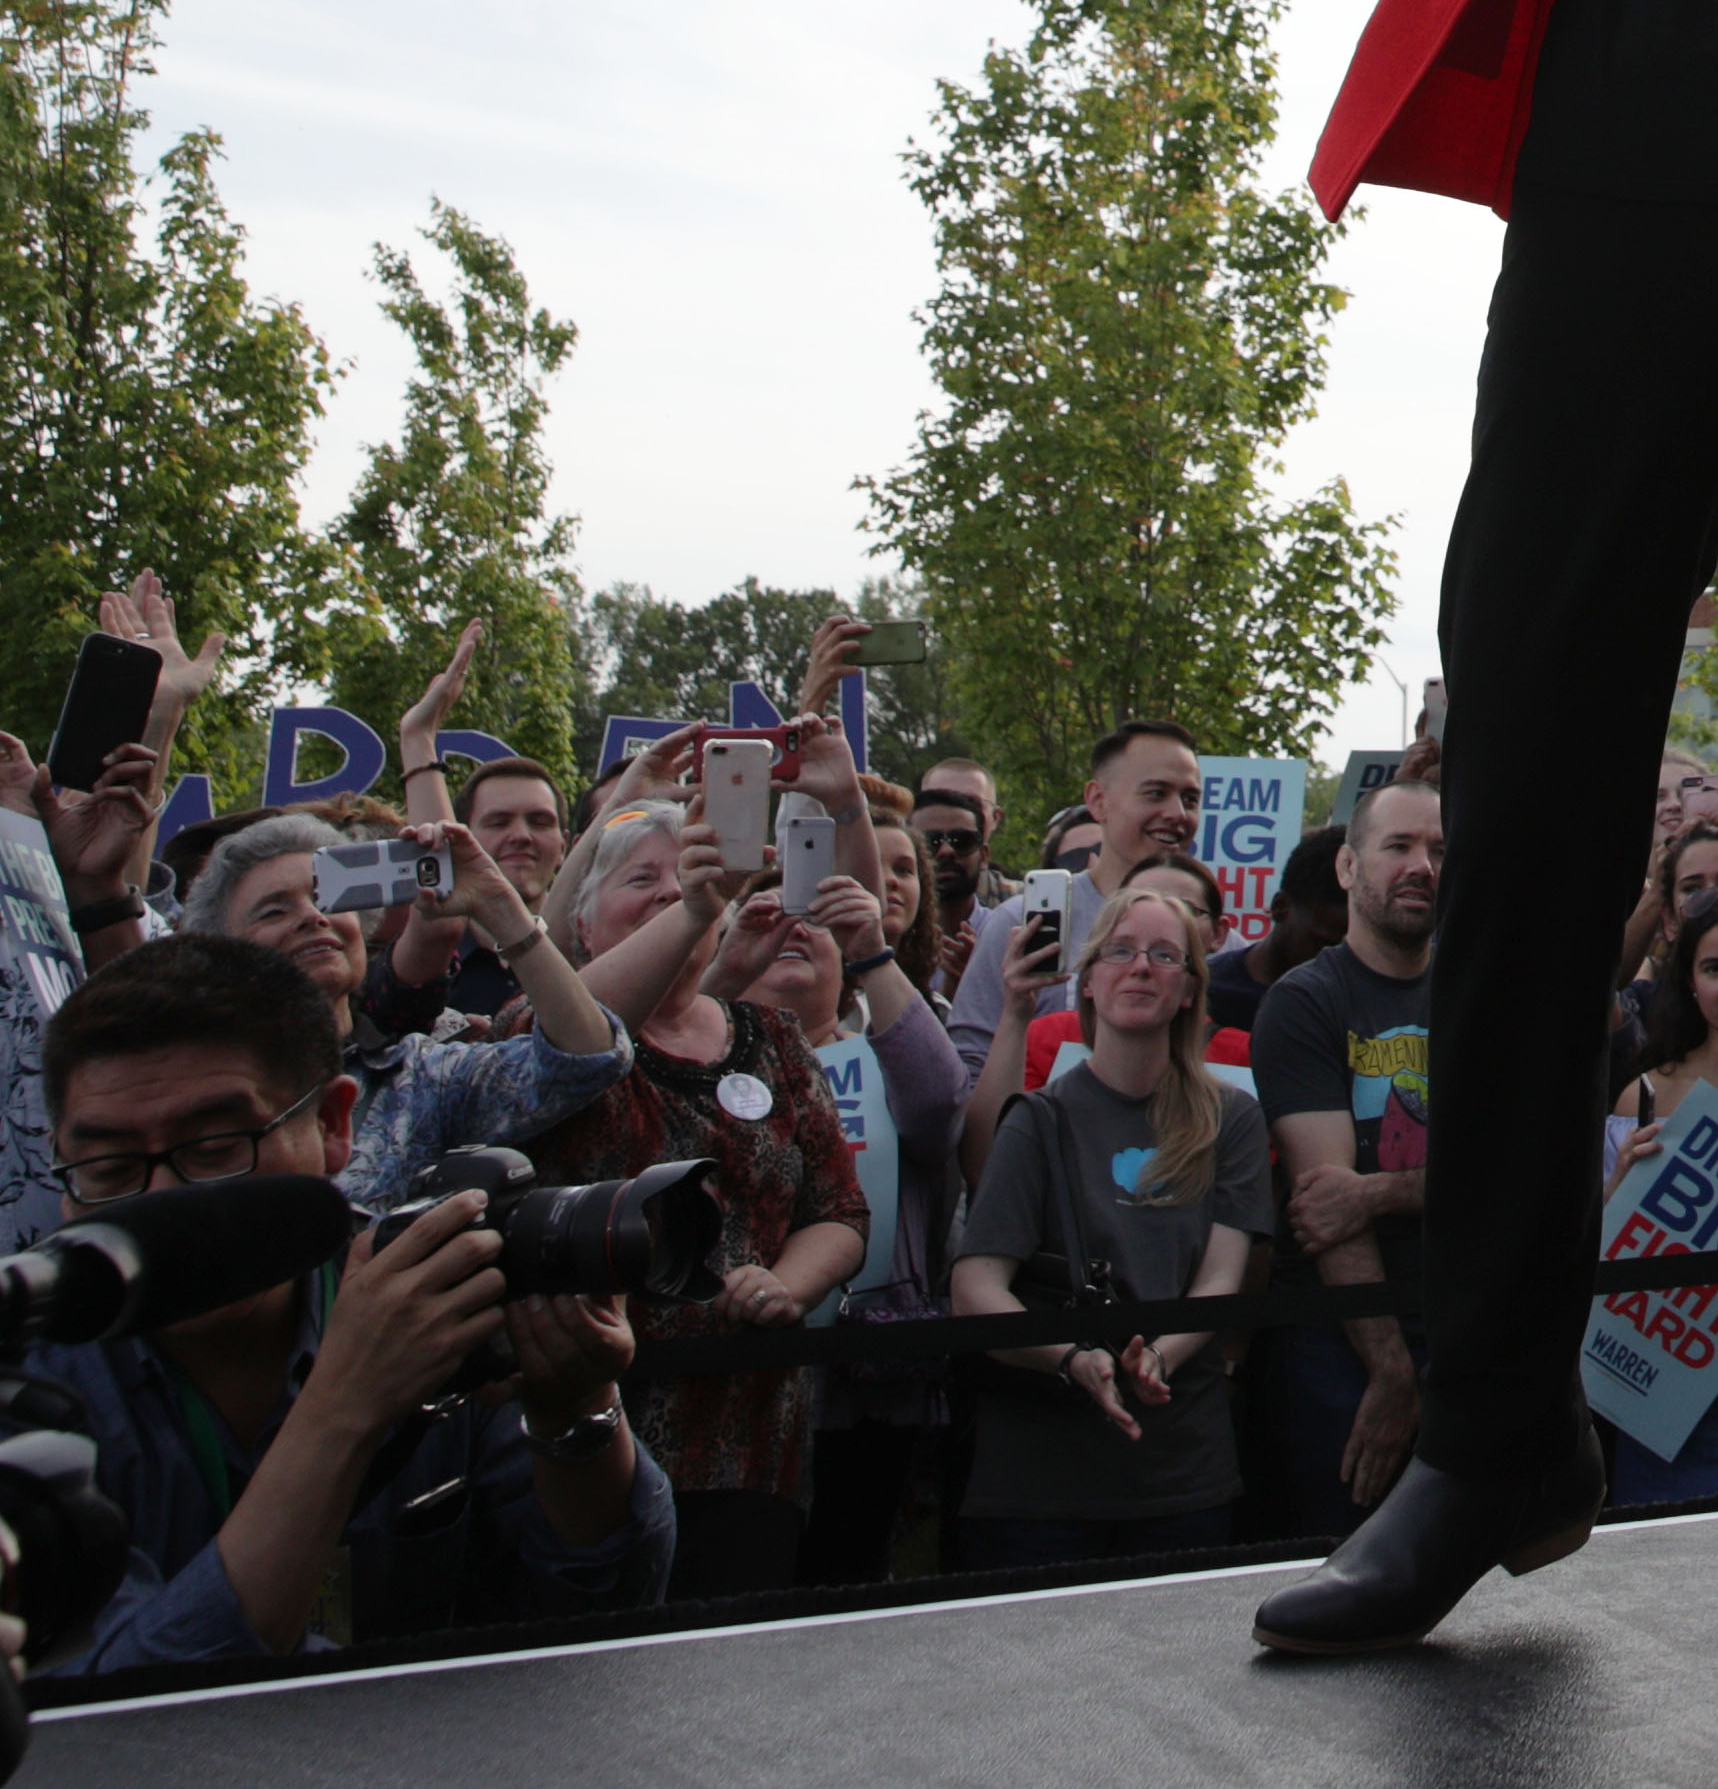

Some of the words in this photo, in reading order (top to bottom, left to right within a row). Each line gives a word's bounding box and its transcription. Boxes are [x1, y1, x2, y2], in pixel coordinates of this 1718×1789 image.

[1203, 776, 1282, 812] EAM
[1187, 814, 1277, 864] IG
[1591, 1329, 1661, 1389] WARREN
